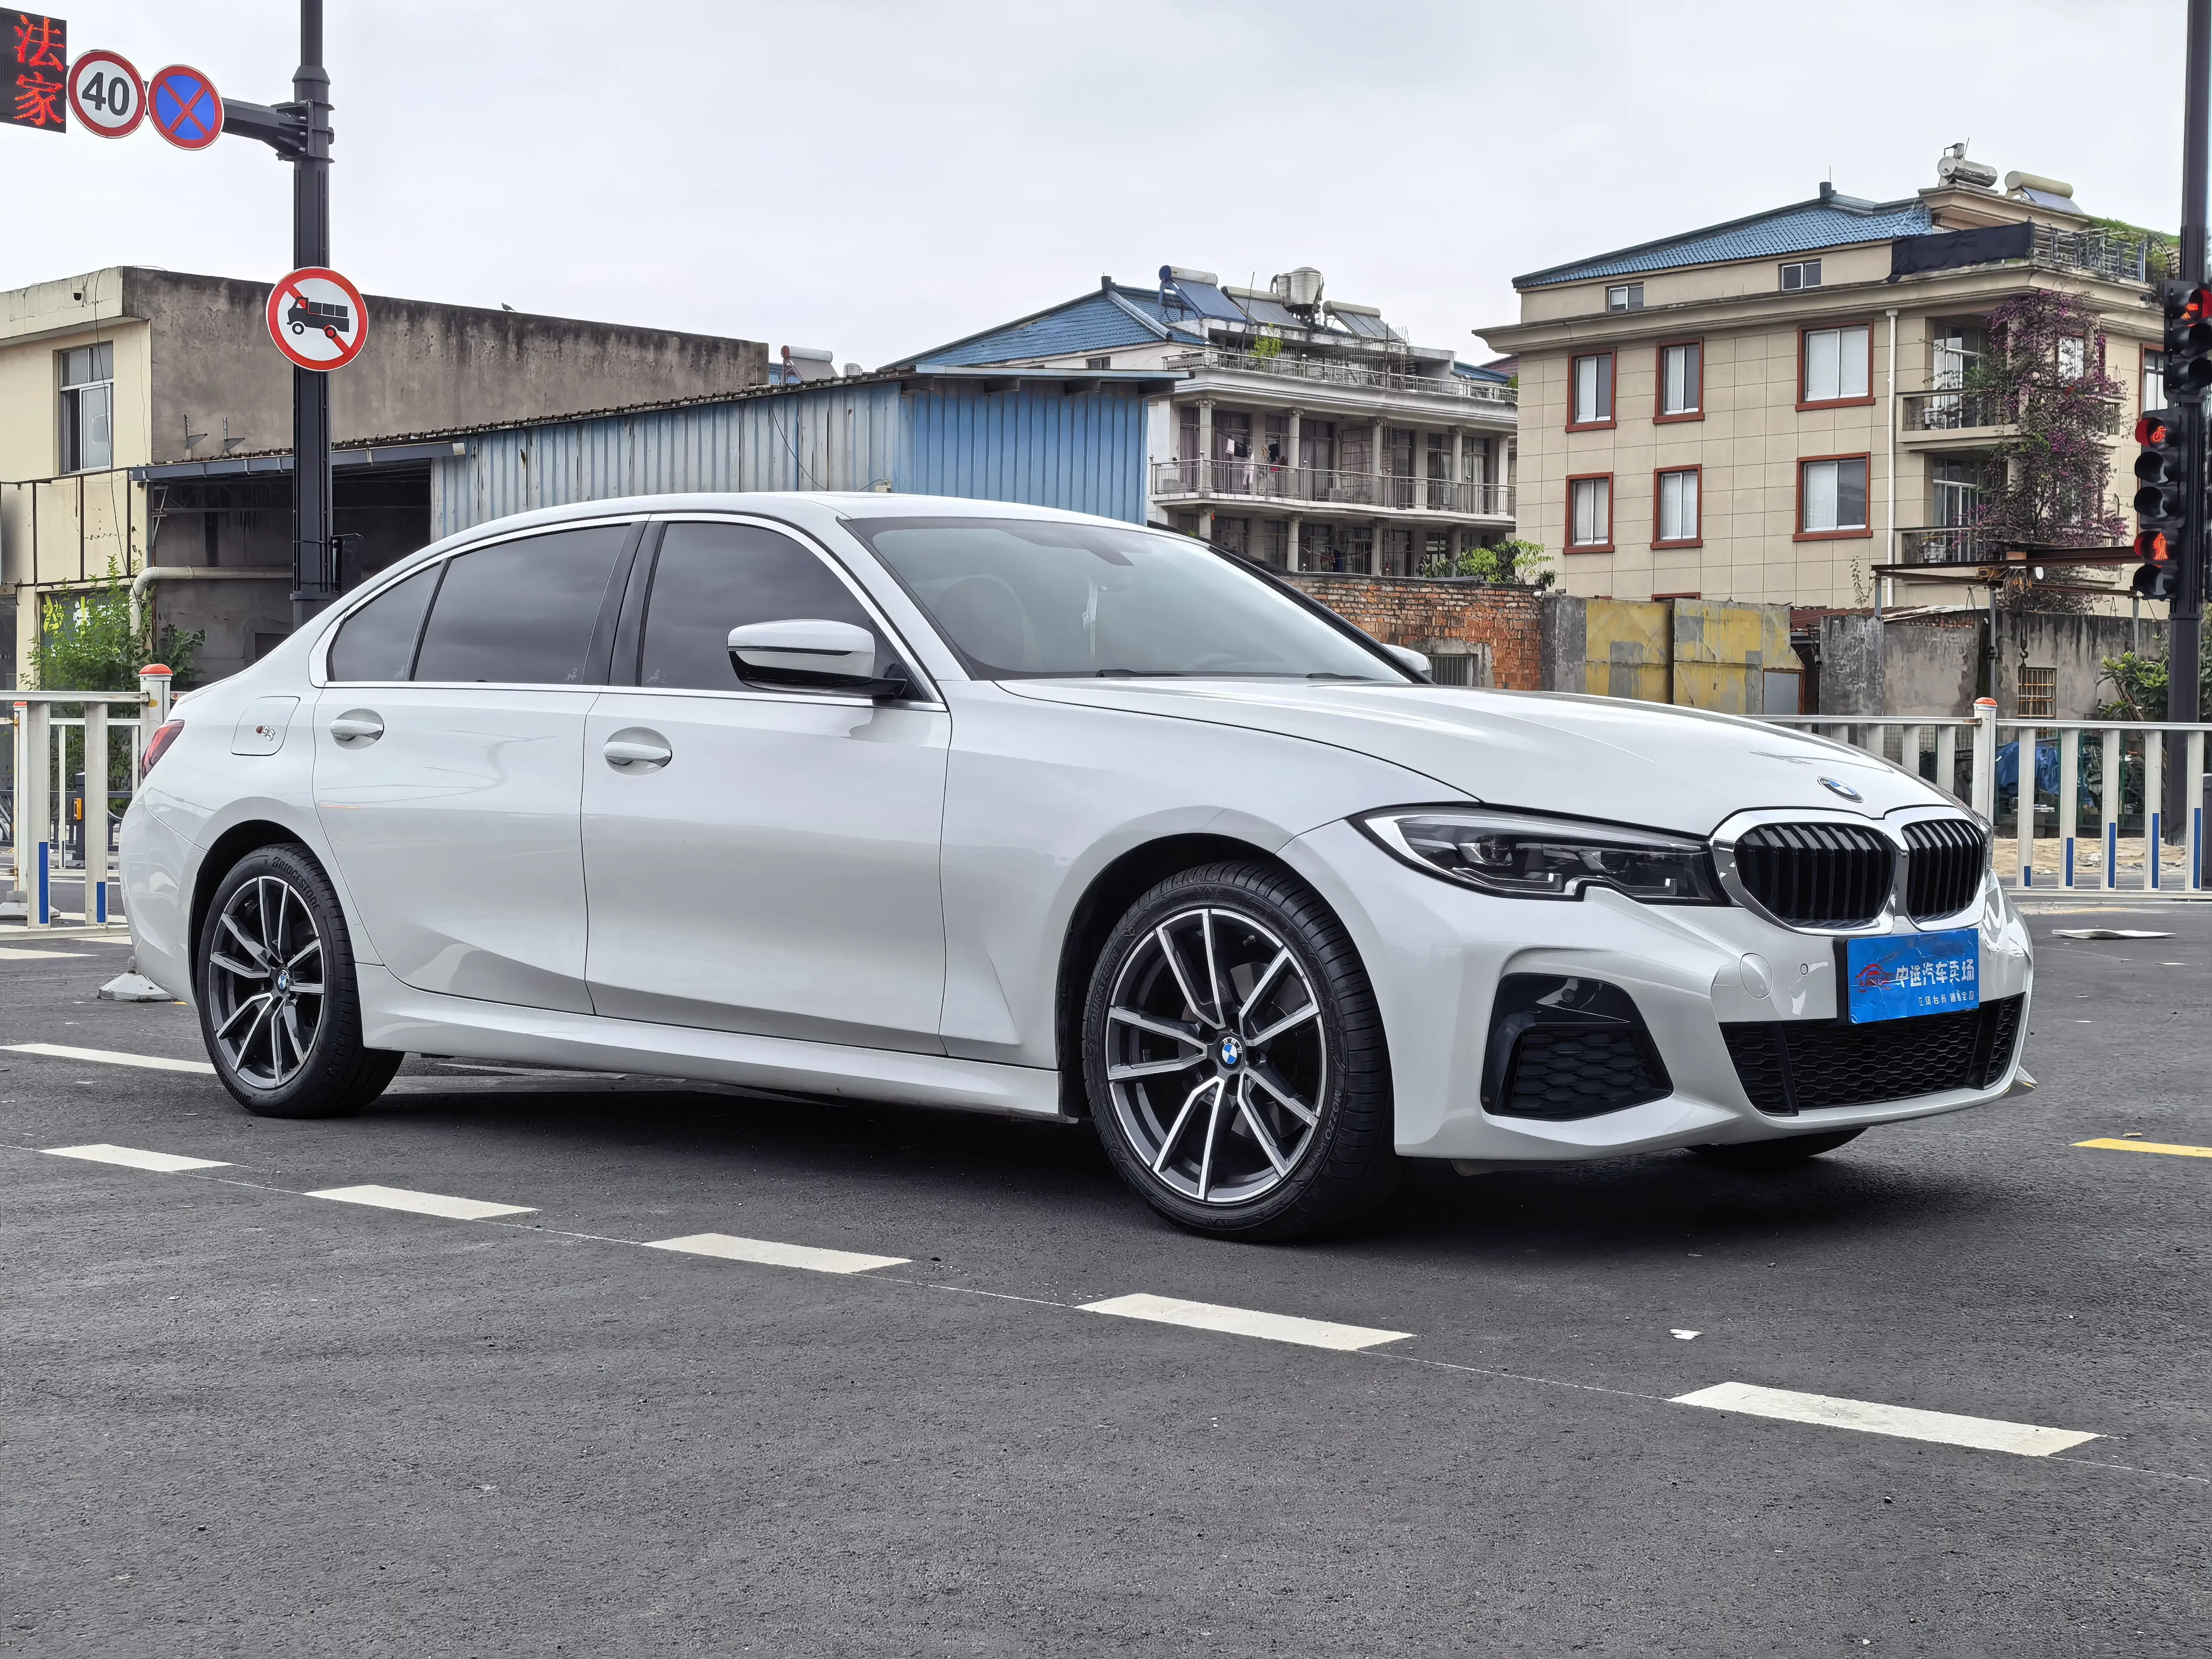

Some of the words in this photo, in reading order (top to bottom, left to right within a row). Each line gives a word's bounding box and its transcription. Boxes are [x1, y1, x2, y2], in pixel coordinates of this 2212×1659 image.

[82, 71, 129, 116] 40
[272, 856, 321, 912] BRIDGESTONE
[1222, 1038, 1243, 1054] BMW
